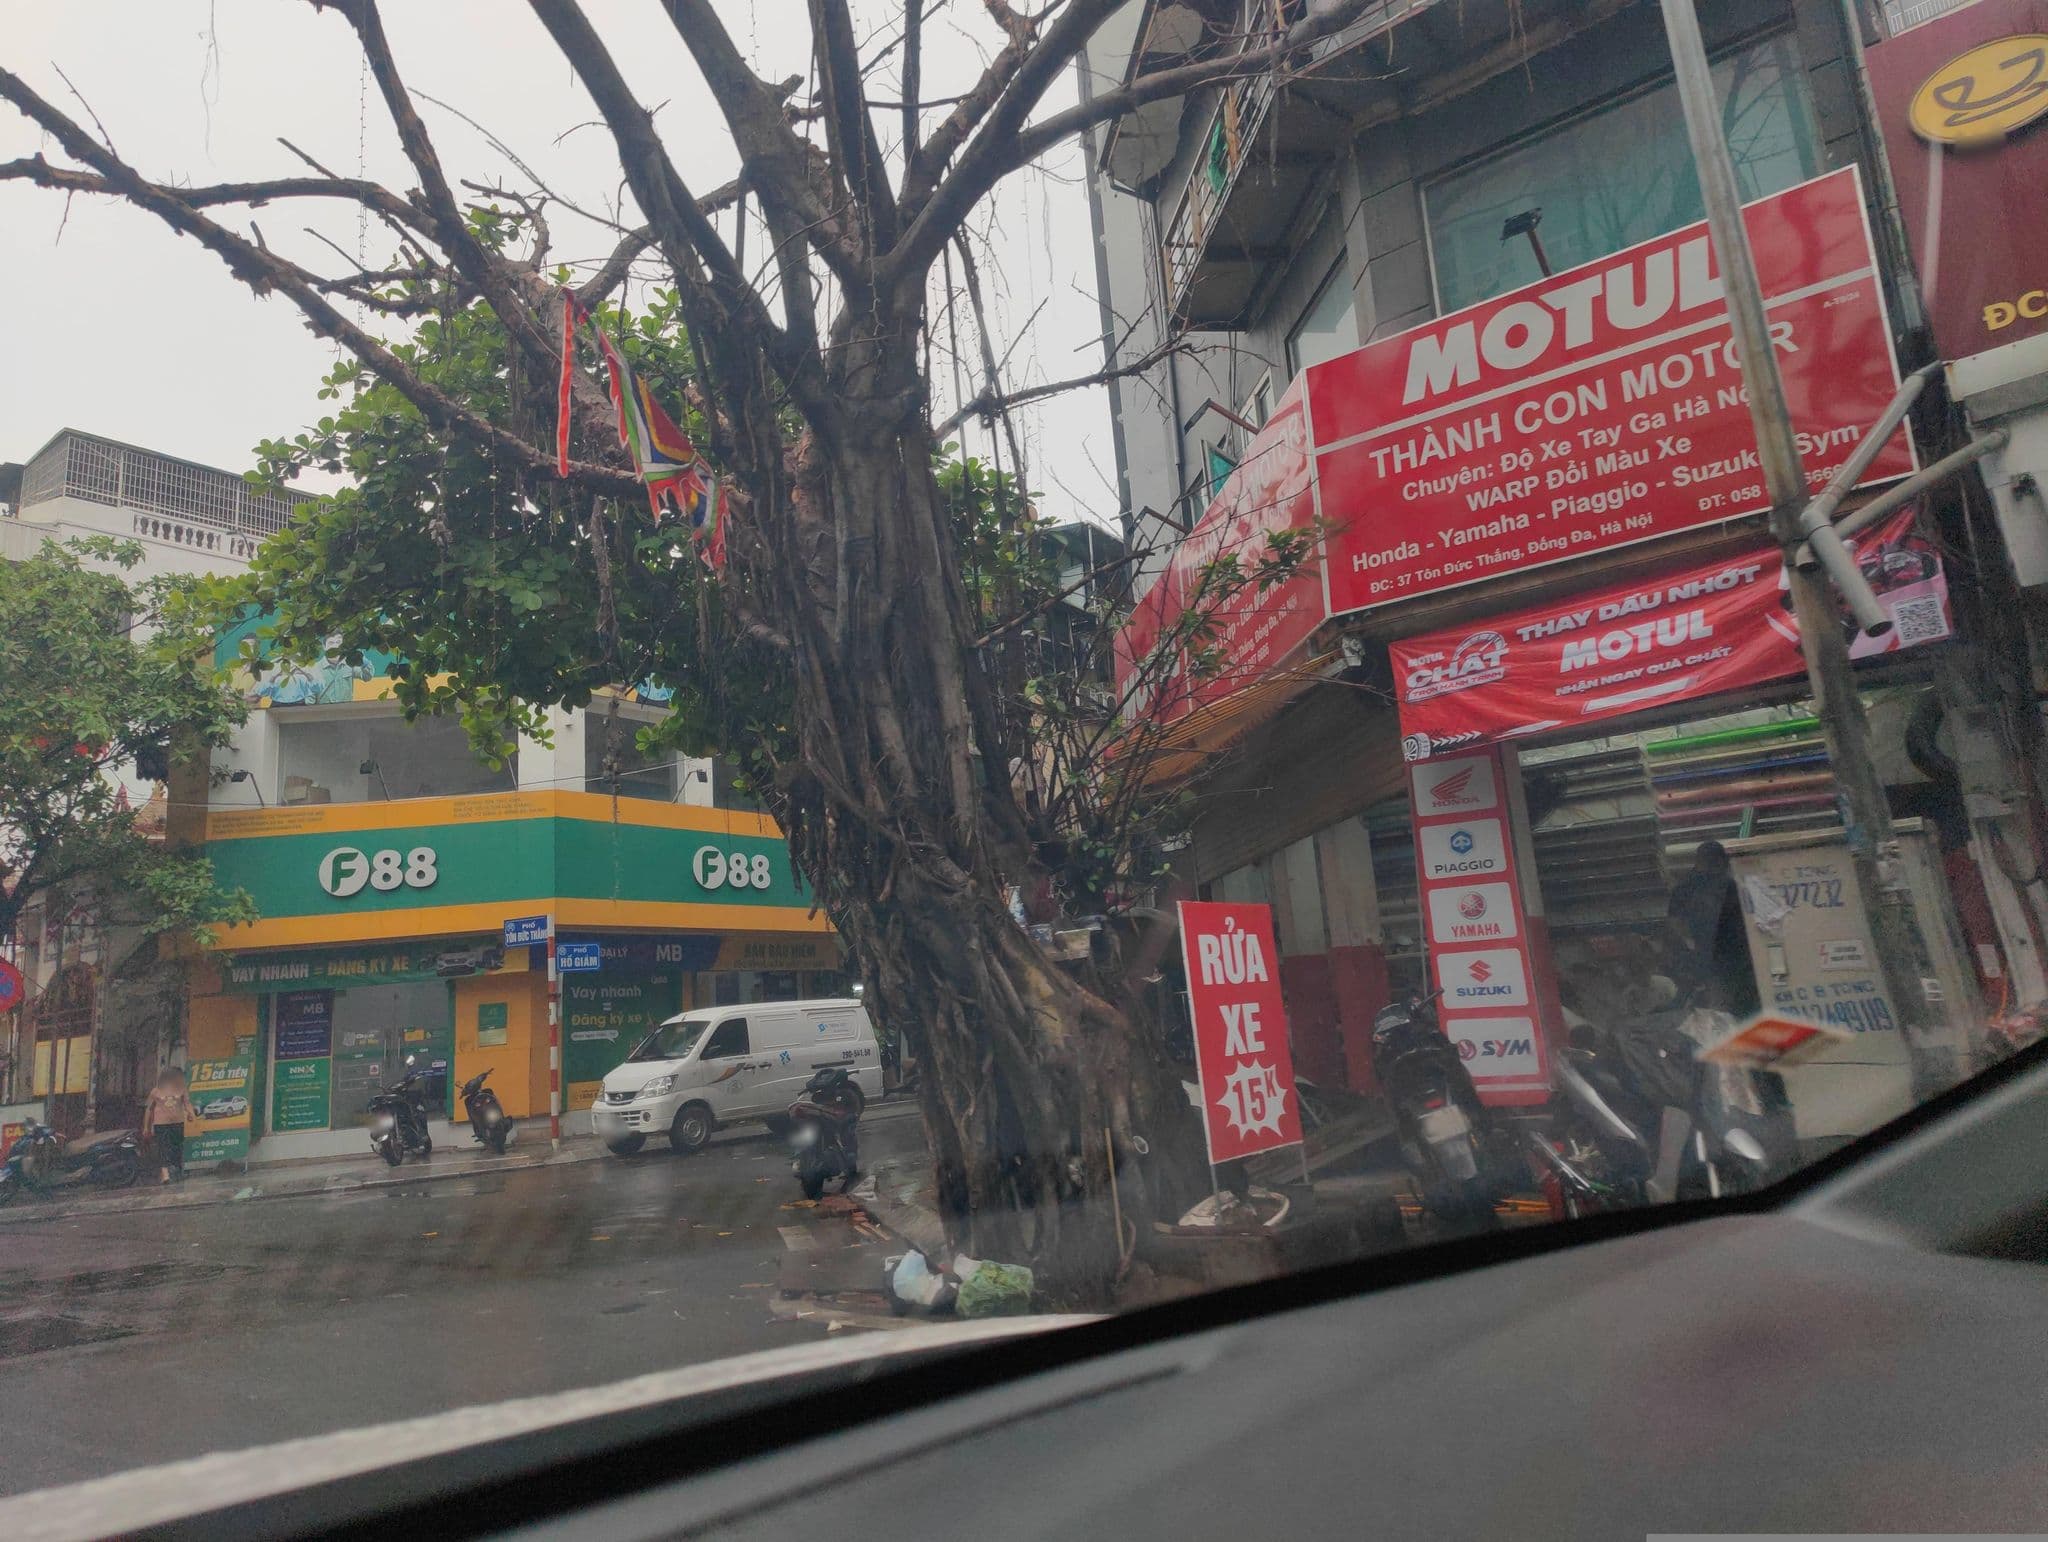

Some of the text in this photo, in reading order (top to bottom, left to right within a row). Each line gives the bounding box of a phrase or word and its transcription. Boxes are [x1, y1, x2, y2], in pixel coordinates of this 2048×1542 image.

[1402, 235, 1727, 406] MOTUL
[1368, 412, 1502, 479] THÀNH
[1514, 378, 1609, 434] CON
[1402, 384, 1751, 501] Chuyên: Độ Xe Tay Ga Hà Nộ
[1465, 436, 1693, 512] WARP Đổi Màu Xe
[1352, 540, 1421, 573] Honda
[1438, 510, 1531, 550] Yamaha
[1551, 476, 1648, 522] Piaggio
[1672, 449, 1762, 487] Suzuk
[1792, 424, 1860, 457] Sym
[1698, 493, 1727, 511] ĐT:
[1730, 485, 1762, 504] 058
[1370, 511, 1654, 595] ĐC: 37 Tôn Đức Thắng, Đống Đa, Hà Nội
[1516, 608, 1594, 642] THAY
[1668, 564, 1761, 604] NHỚT
[1560, 608, 1713, 673] MOTUL
[1408, 651, 1445, 668] MOTUL
[1555, 646, 1732, 697] NHẬN NGAY QUÀ CHẤT
[319, 846, 438, 897] F88
[692, 845, 771, 890] F88
[1434, 859, 1496, 874] PIAGGIO
[522, 920, 536, 930] PHỐ
[1451, 924, 1502, 938] YAMAHA
[656, 943, 683, 962] MB
[1197, 916, 1269, 985] RỬA
[231, 967, 256, 983] VAY
[259, 962, 310, 981] NHANH
[391, 955, 409, 971] XE
[303, 1002, 324, 1014] MB
[570, 984, 642, 1001] Vay nhanh
[1456, 985, 1513, 998] SUZUKI
[571, 1013, 606, 1028] Đăng
[627, 1014, 642, 1023] xe
[1219, 1002, 1266, 1057] XE
[1481, 1039, 1532, 1057] SYM
[191, 1063, 214, 1081] 15
